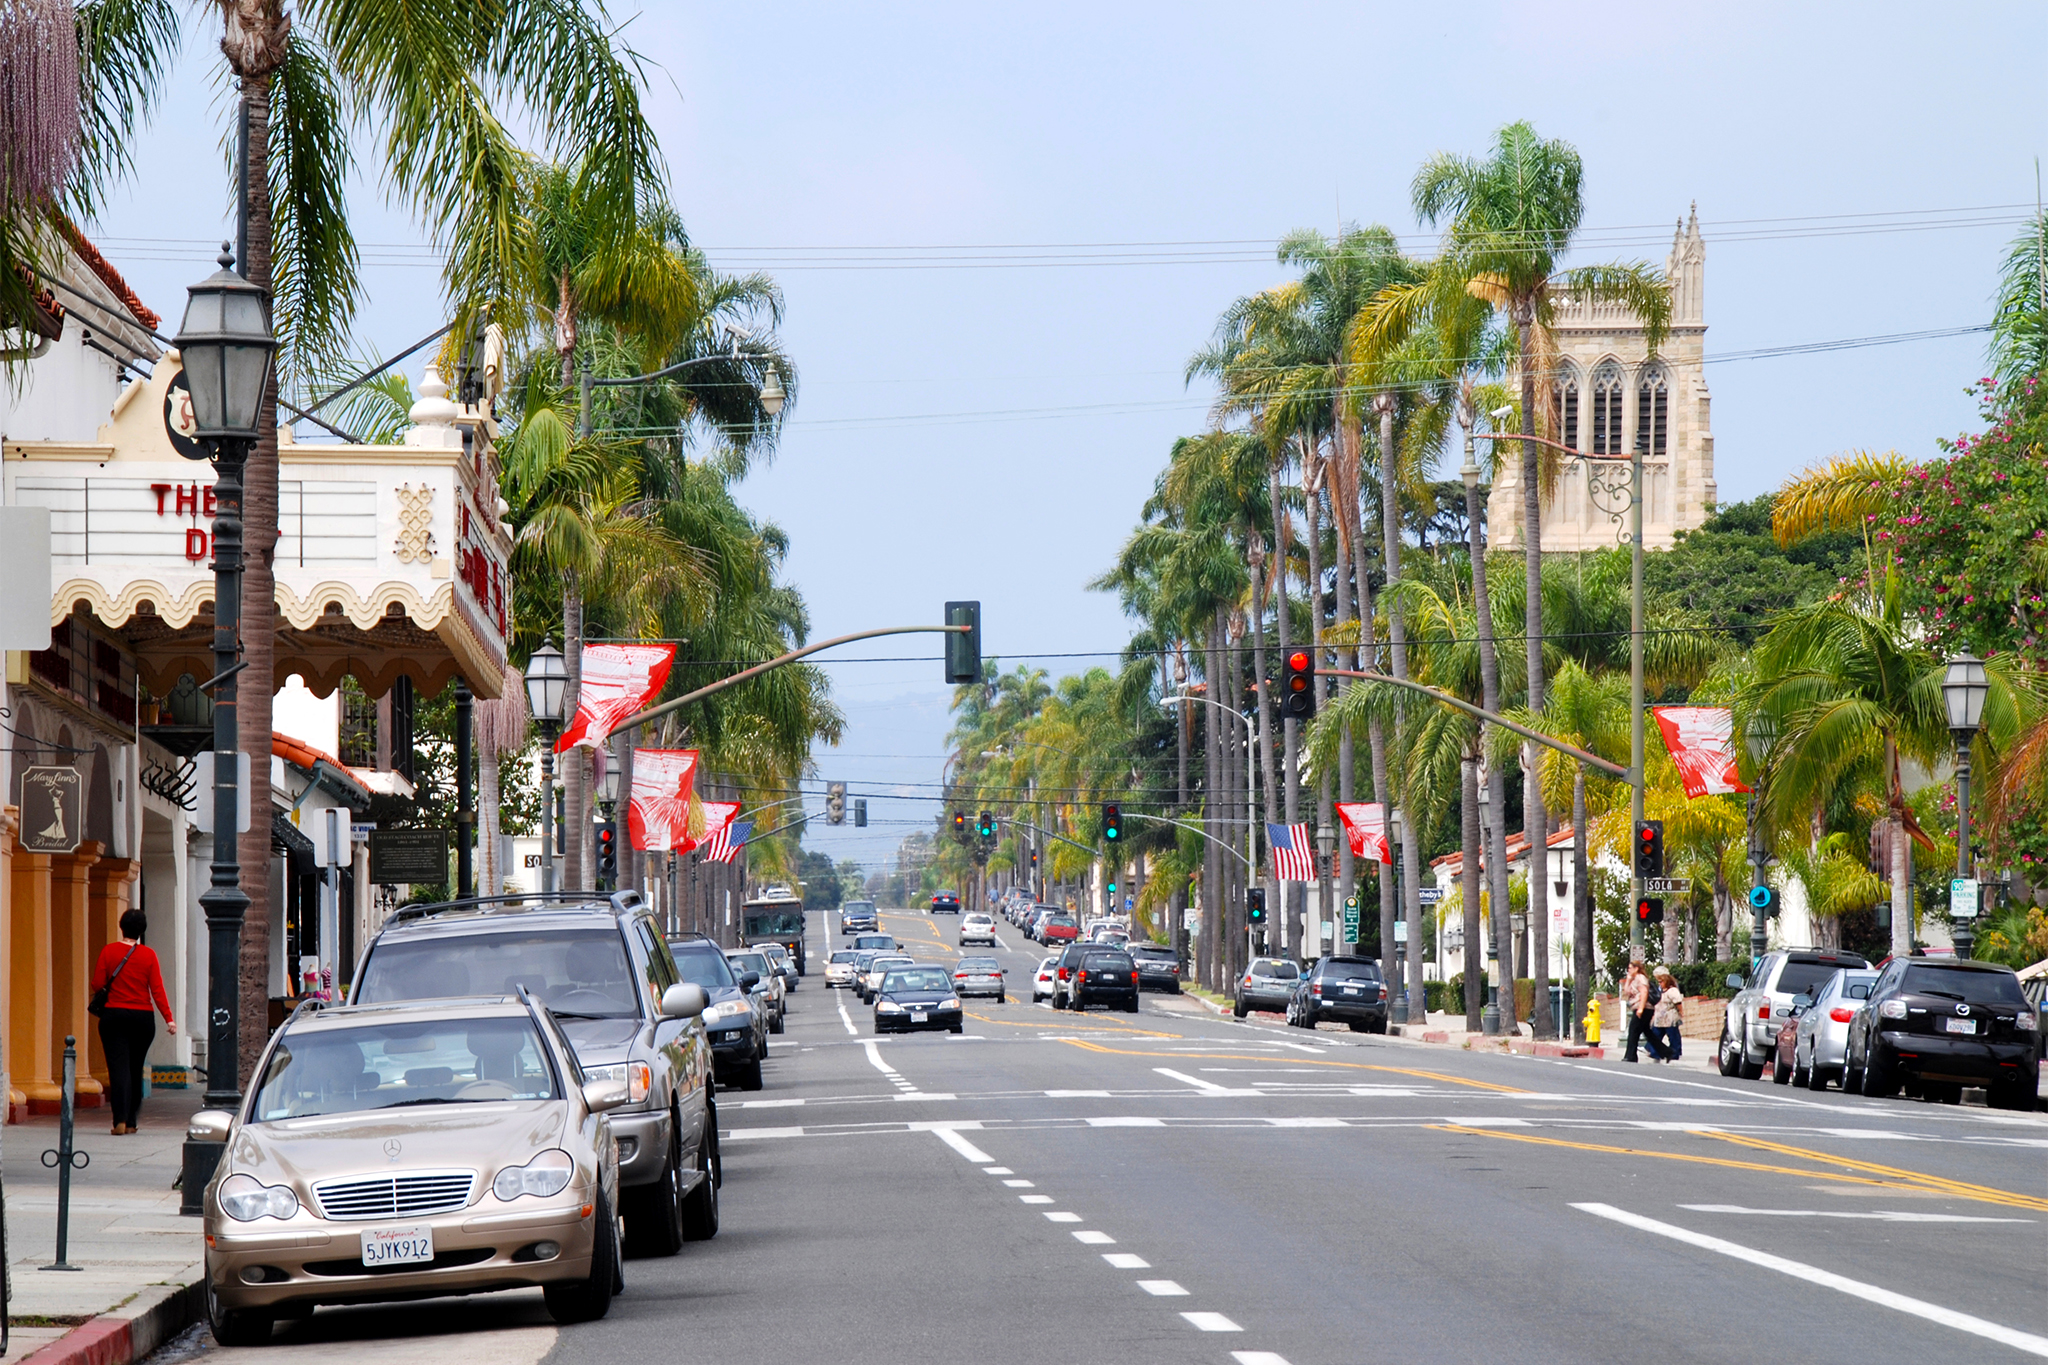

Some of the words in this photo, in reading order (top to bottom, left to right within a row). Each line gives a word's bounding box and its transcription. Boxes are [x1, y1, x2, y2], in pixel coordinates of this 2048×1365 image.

[151, 484, 216, 517] THE
[31, 836, 69, 847] Bridal
[527, 855, 541, 867] SO
[1648, 880, 1673, 890] SOLA
[1953, 882, 1964, 890] 90
[1419, 890, 1442, 899] theby's
[376, 1231, 418, 1240] California
[366, 1239, 429, 1261] 5JYK912
